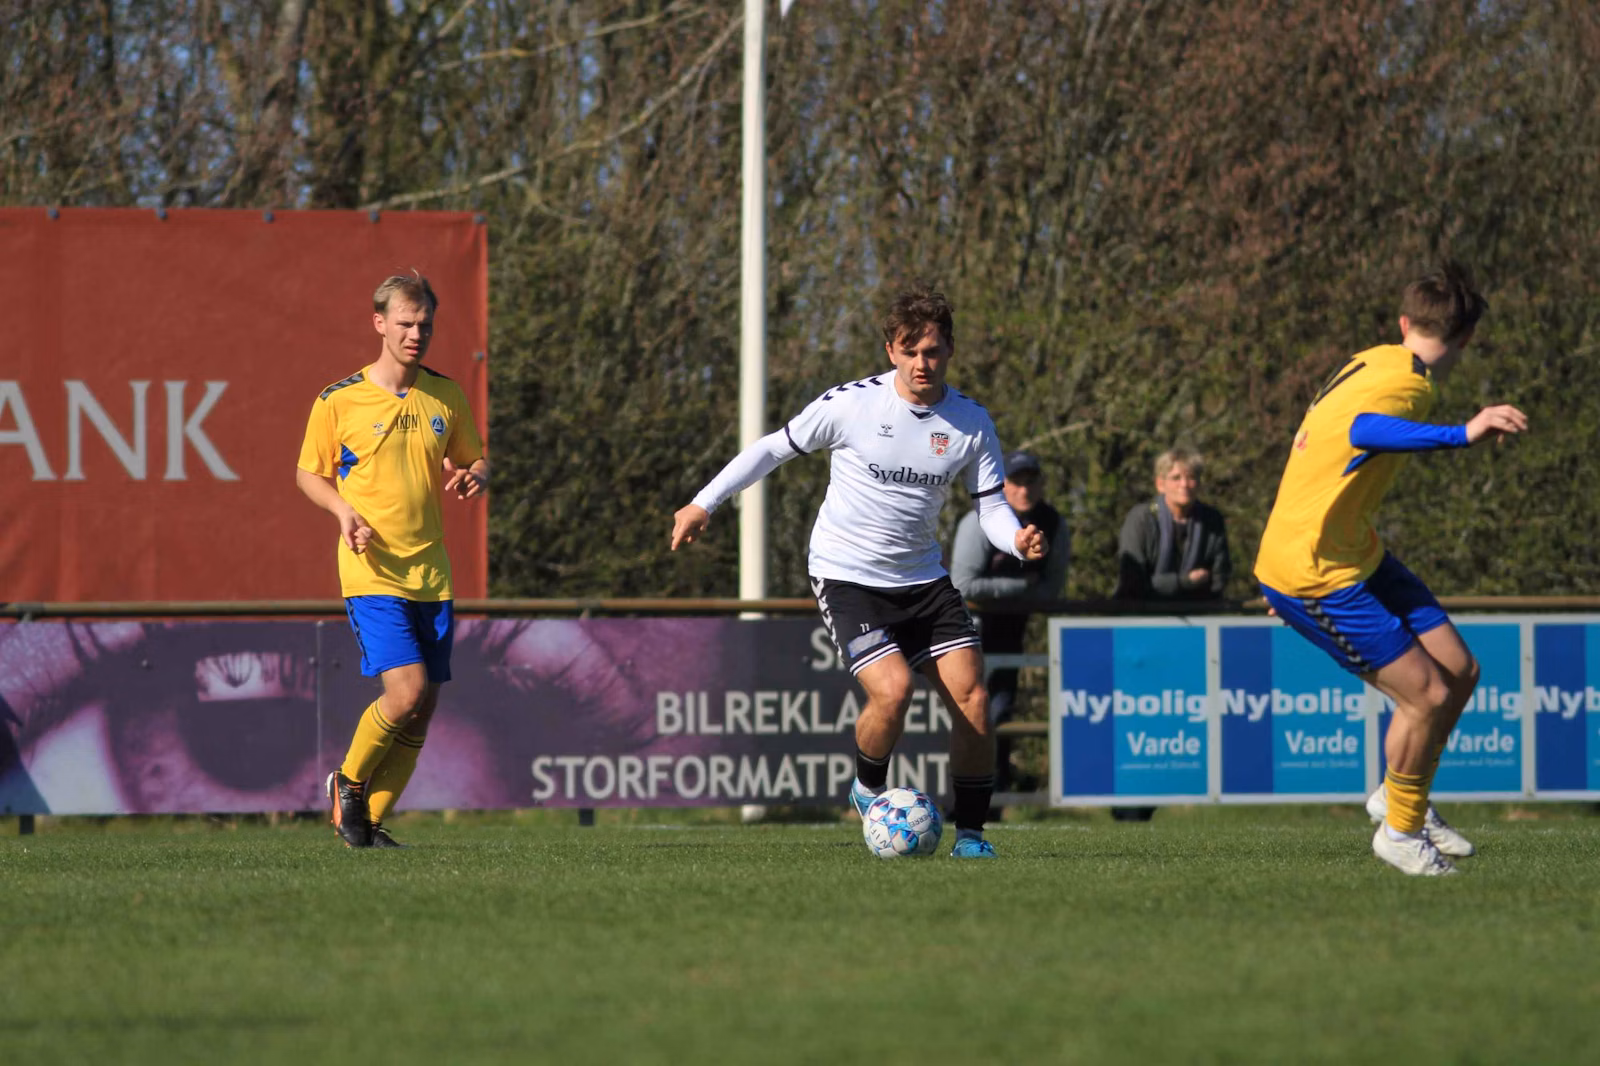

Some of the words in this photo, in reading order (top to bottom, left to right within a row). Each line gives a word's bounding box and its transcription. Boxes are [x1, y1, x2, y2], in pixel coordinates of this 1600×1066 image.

[860, 623, 870, 633] 11
[656, 691, 955, 735] BILREKLAER
[1061, 689, 1210, 723] Nybolig
[1219, 688, 1368, 722] Nybolig
[1126, 729, 1201, 756] Varde
[1284, 729, 1359, 754] Varde
[531, 752, 951, 800] STORFORMATPINT
